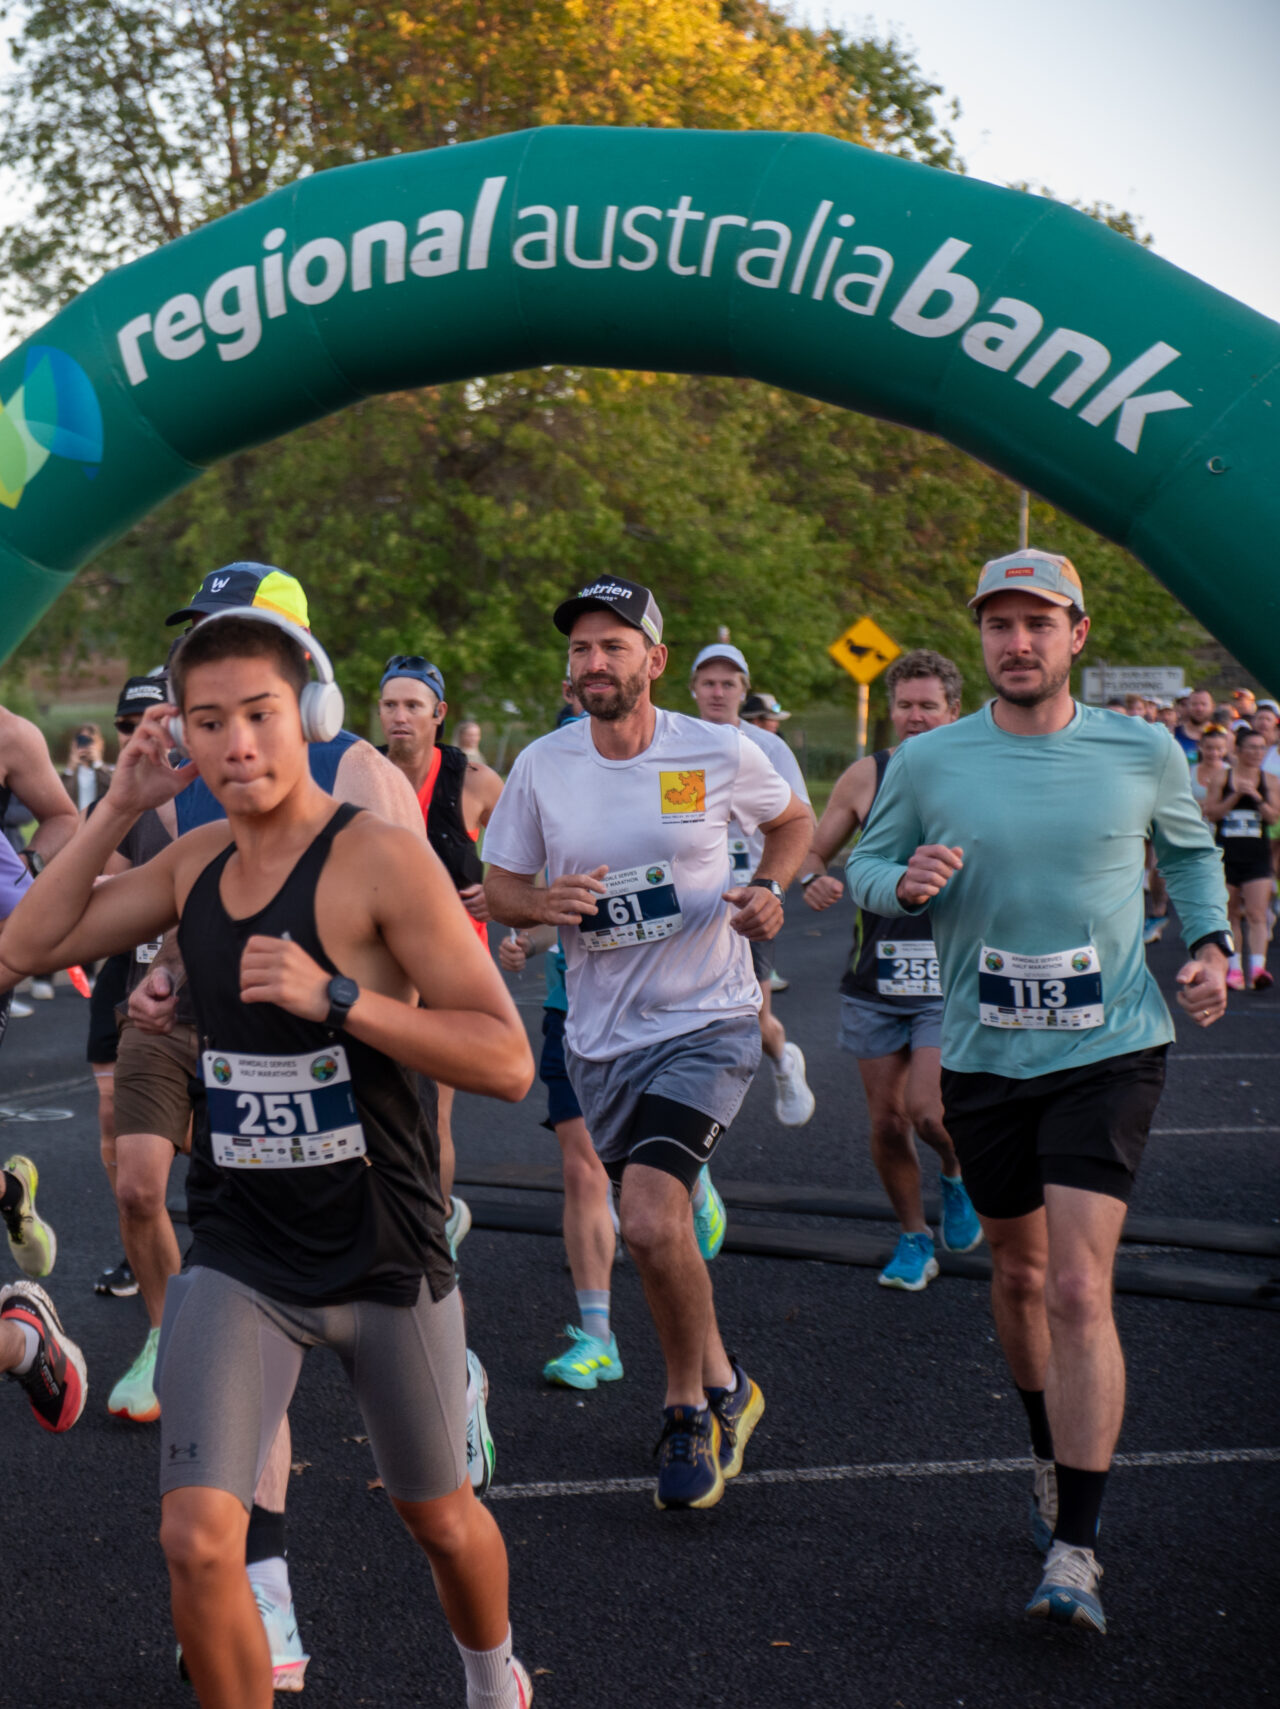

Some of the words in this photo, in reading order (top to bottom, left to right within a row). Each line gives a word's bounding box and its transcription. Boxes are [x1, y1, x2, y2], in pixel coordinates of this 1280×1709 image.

[117, 175, 508, 386] regional
[512, 195, 895, 317] australia
[889, 237, 1194, 455] bank
[607, 893, 644, 925] 61
[892, 959, 940, 980] 256
[1008, 979, 1068, 1008] 113
[235, 1091, 319, 1136] 251
